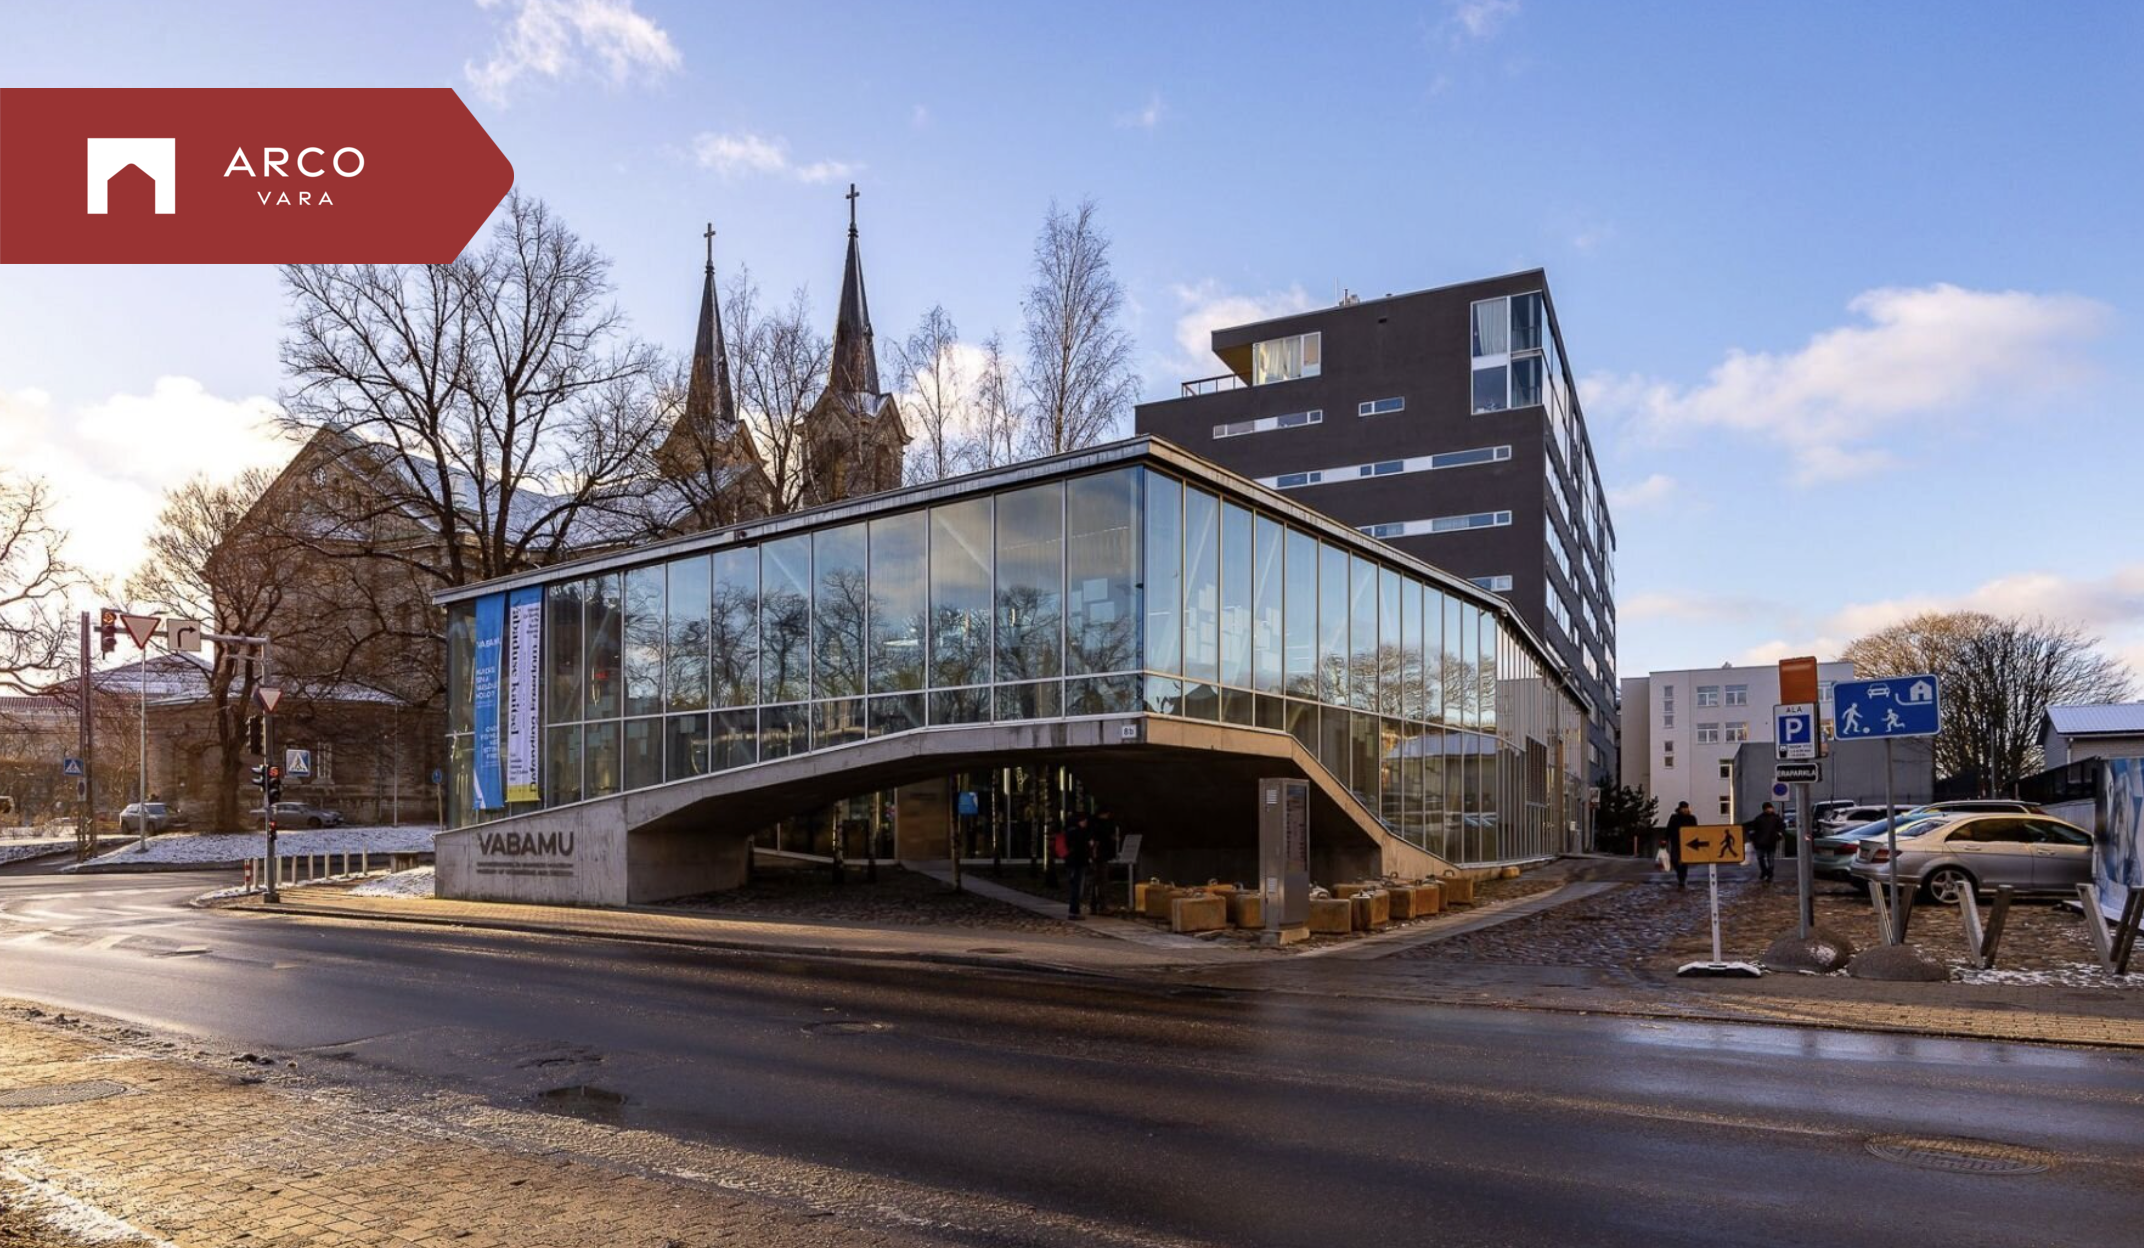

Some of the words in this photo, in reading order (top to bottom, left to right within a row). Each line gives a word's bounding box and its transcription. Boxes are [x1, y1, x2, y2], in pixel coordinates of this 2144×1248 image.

[1786, 705, 1803, 713] ALA
[1785, 718, 1803, 742] P
[477, 831, 574, 856] VABAMU
